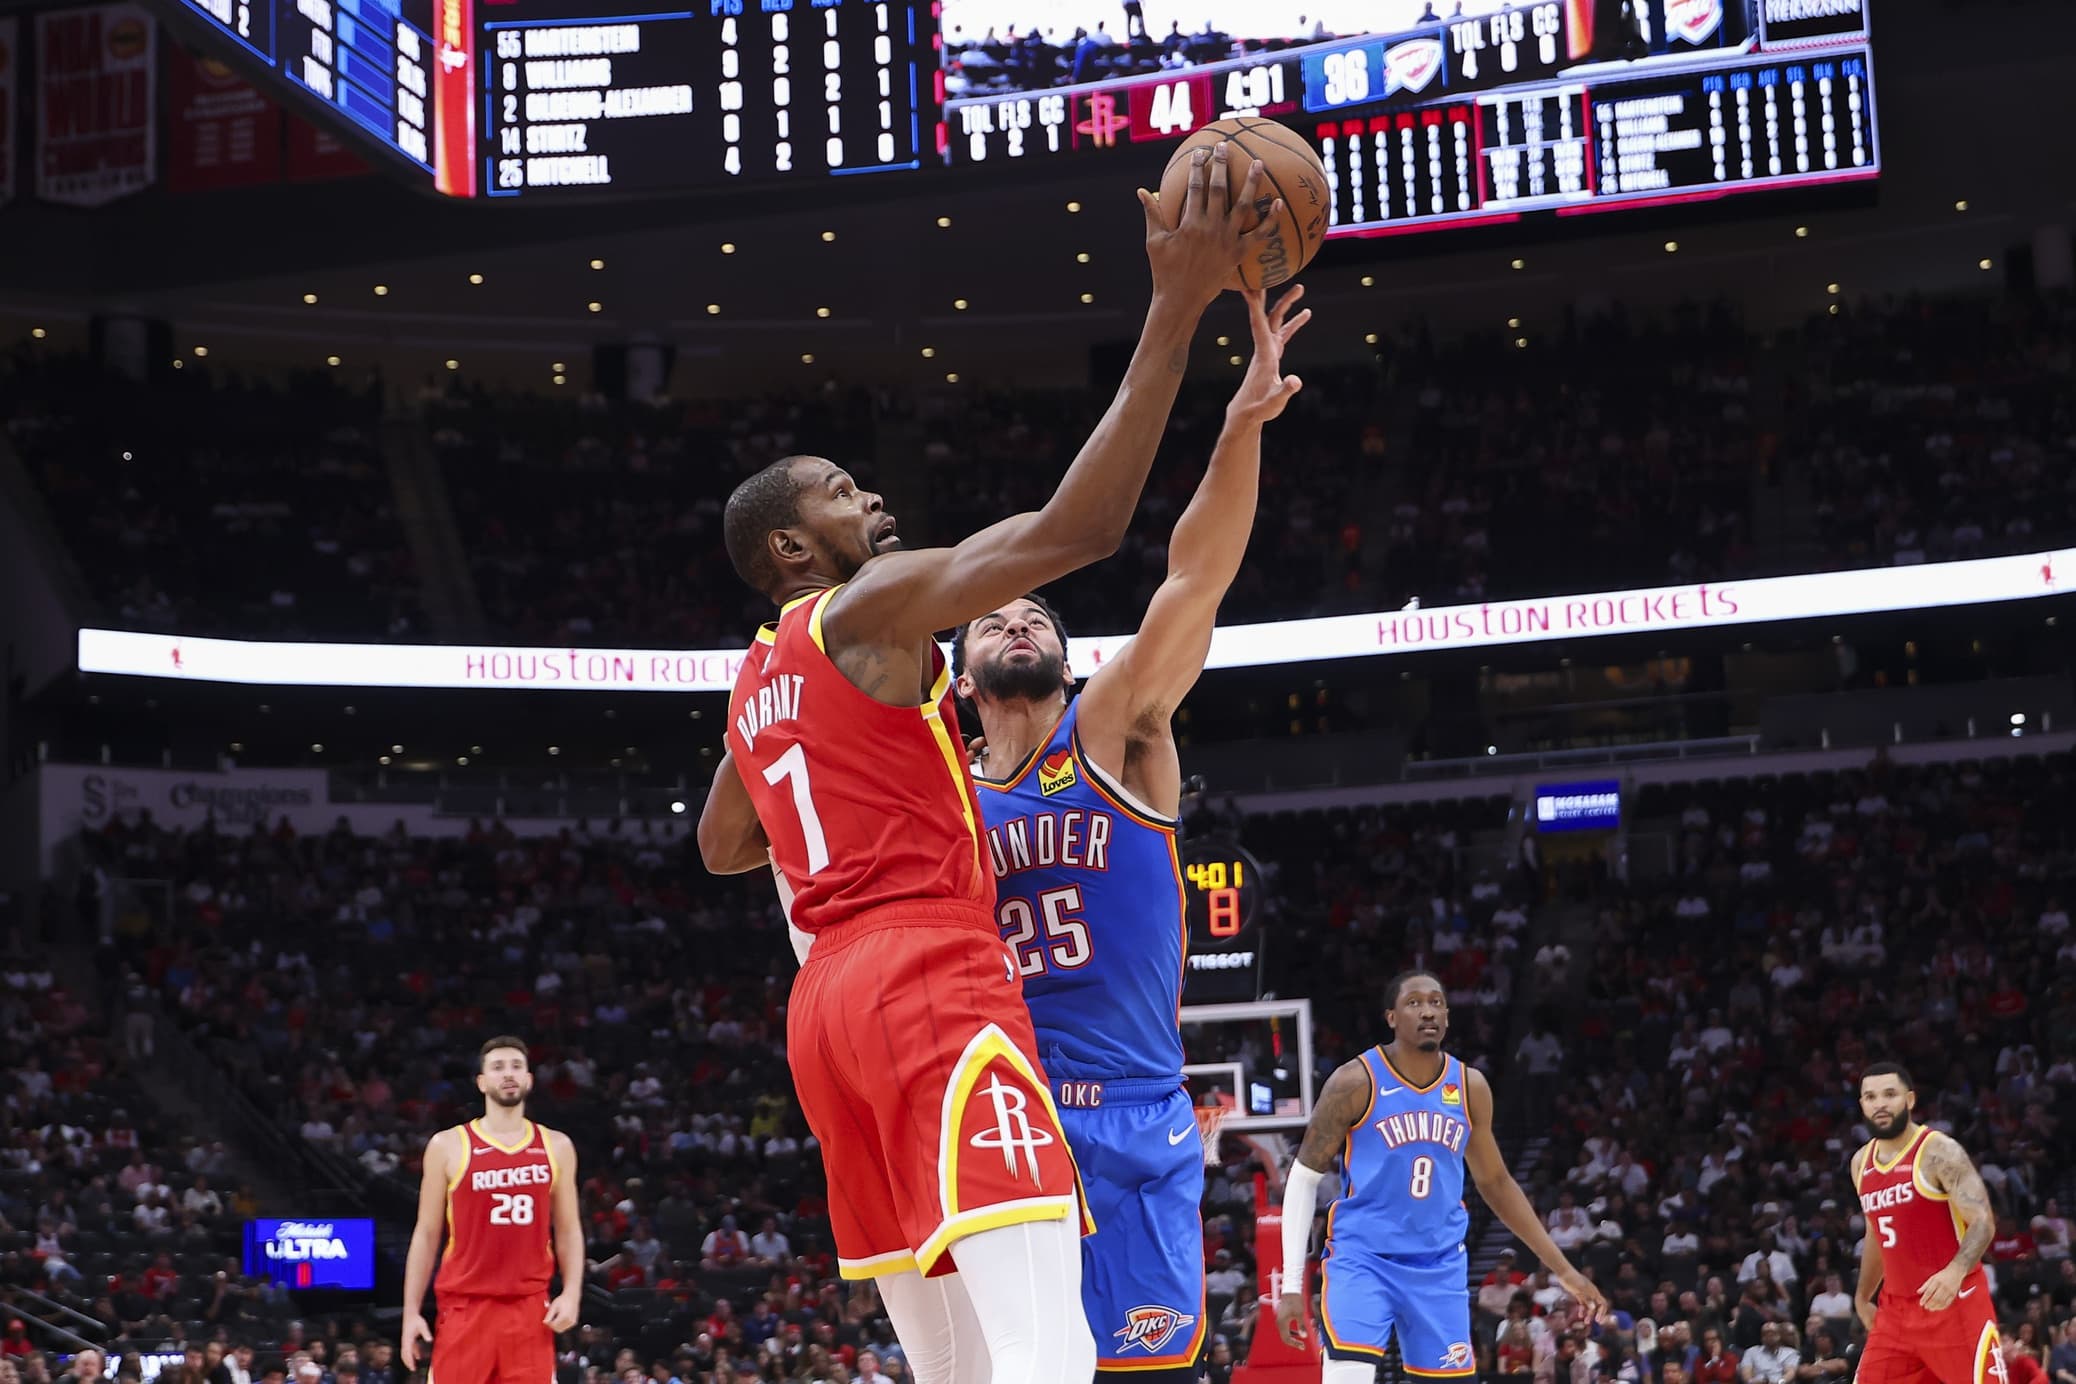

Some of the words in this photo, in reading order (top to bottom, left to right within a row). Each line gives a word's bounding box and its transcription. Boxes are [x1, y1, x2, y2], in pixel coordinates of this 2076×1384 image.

[825, 9, 837, 36] 1
[876, 4, 887, 31] 1
[504, 95, 517, 122] 2
[878, 68, 890, 96] 1
[1225, 63, 1284, 109] 4:01
[1323, 49, 1370, 105] 36
[777, 110, 788, 138] 1
[828, 106, 840, 133] 1
[879, 101, 891, 129] 1
[1150, 81, 1194, 134] 44
[1047, 123, 1059, 152] 1
[499, 159, 523, 187] 25
[1377, 604, 1549, 645] HOUSTON
[1565, 585, 1739, 629] ROCKETS
[466, 649, 635, 682] HOUSTON
[651, 655, 745, 683] ROCK
[737, 674, 804, 752] DURANT
[762, 742, 830, 877] 7
[986, 810, 1112, 881] UNDER
[1187, 861, 1243, 890] 4:01
[998, 884, 1096, 979] 25
[1208, 888, 1240, 936] 8
[1061, 1082, 1102, 1106] OKC
[1374, 1110, 1465, 1152] THUNDER
[471, 1163, 550, 1192] ROCKETS
[1409, 1155, 1434, 1200] 8
[489, 1193, 534, 1225] 28
[265, 1238, 348, 1260] ULTRA
[1877, 1215, 1897, 1248] 5
[1127, 1315, 1168, 1342] OKC
